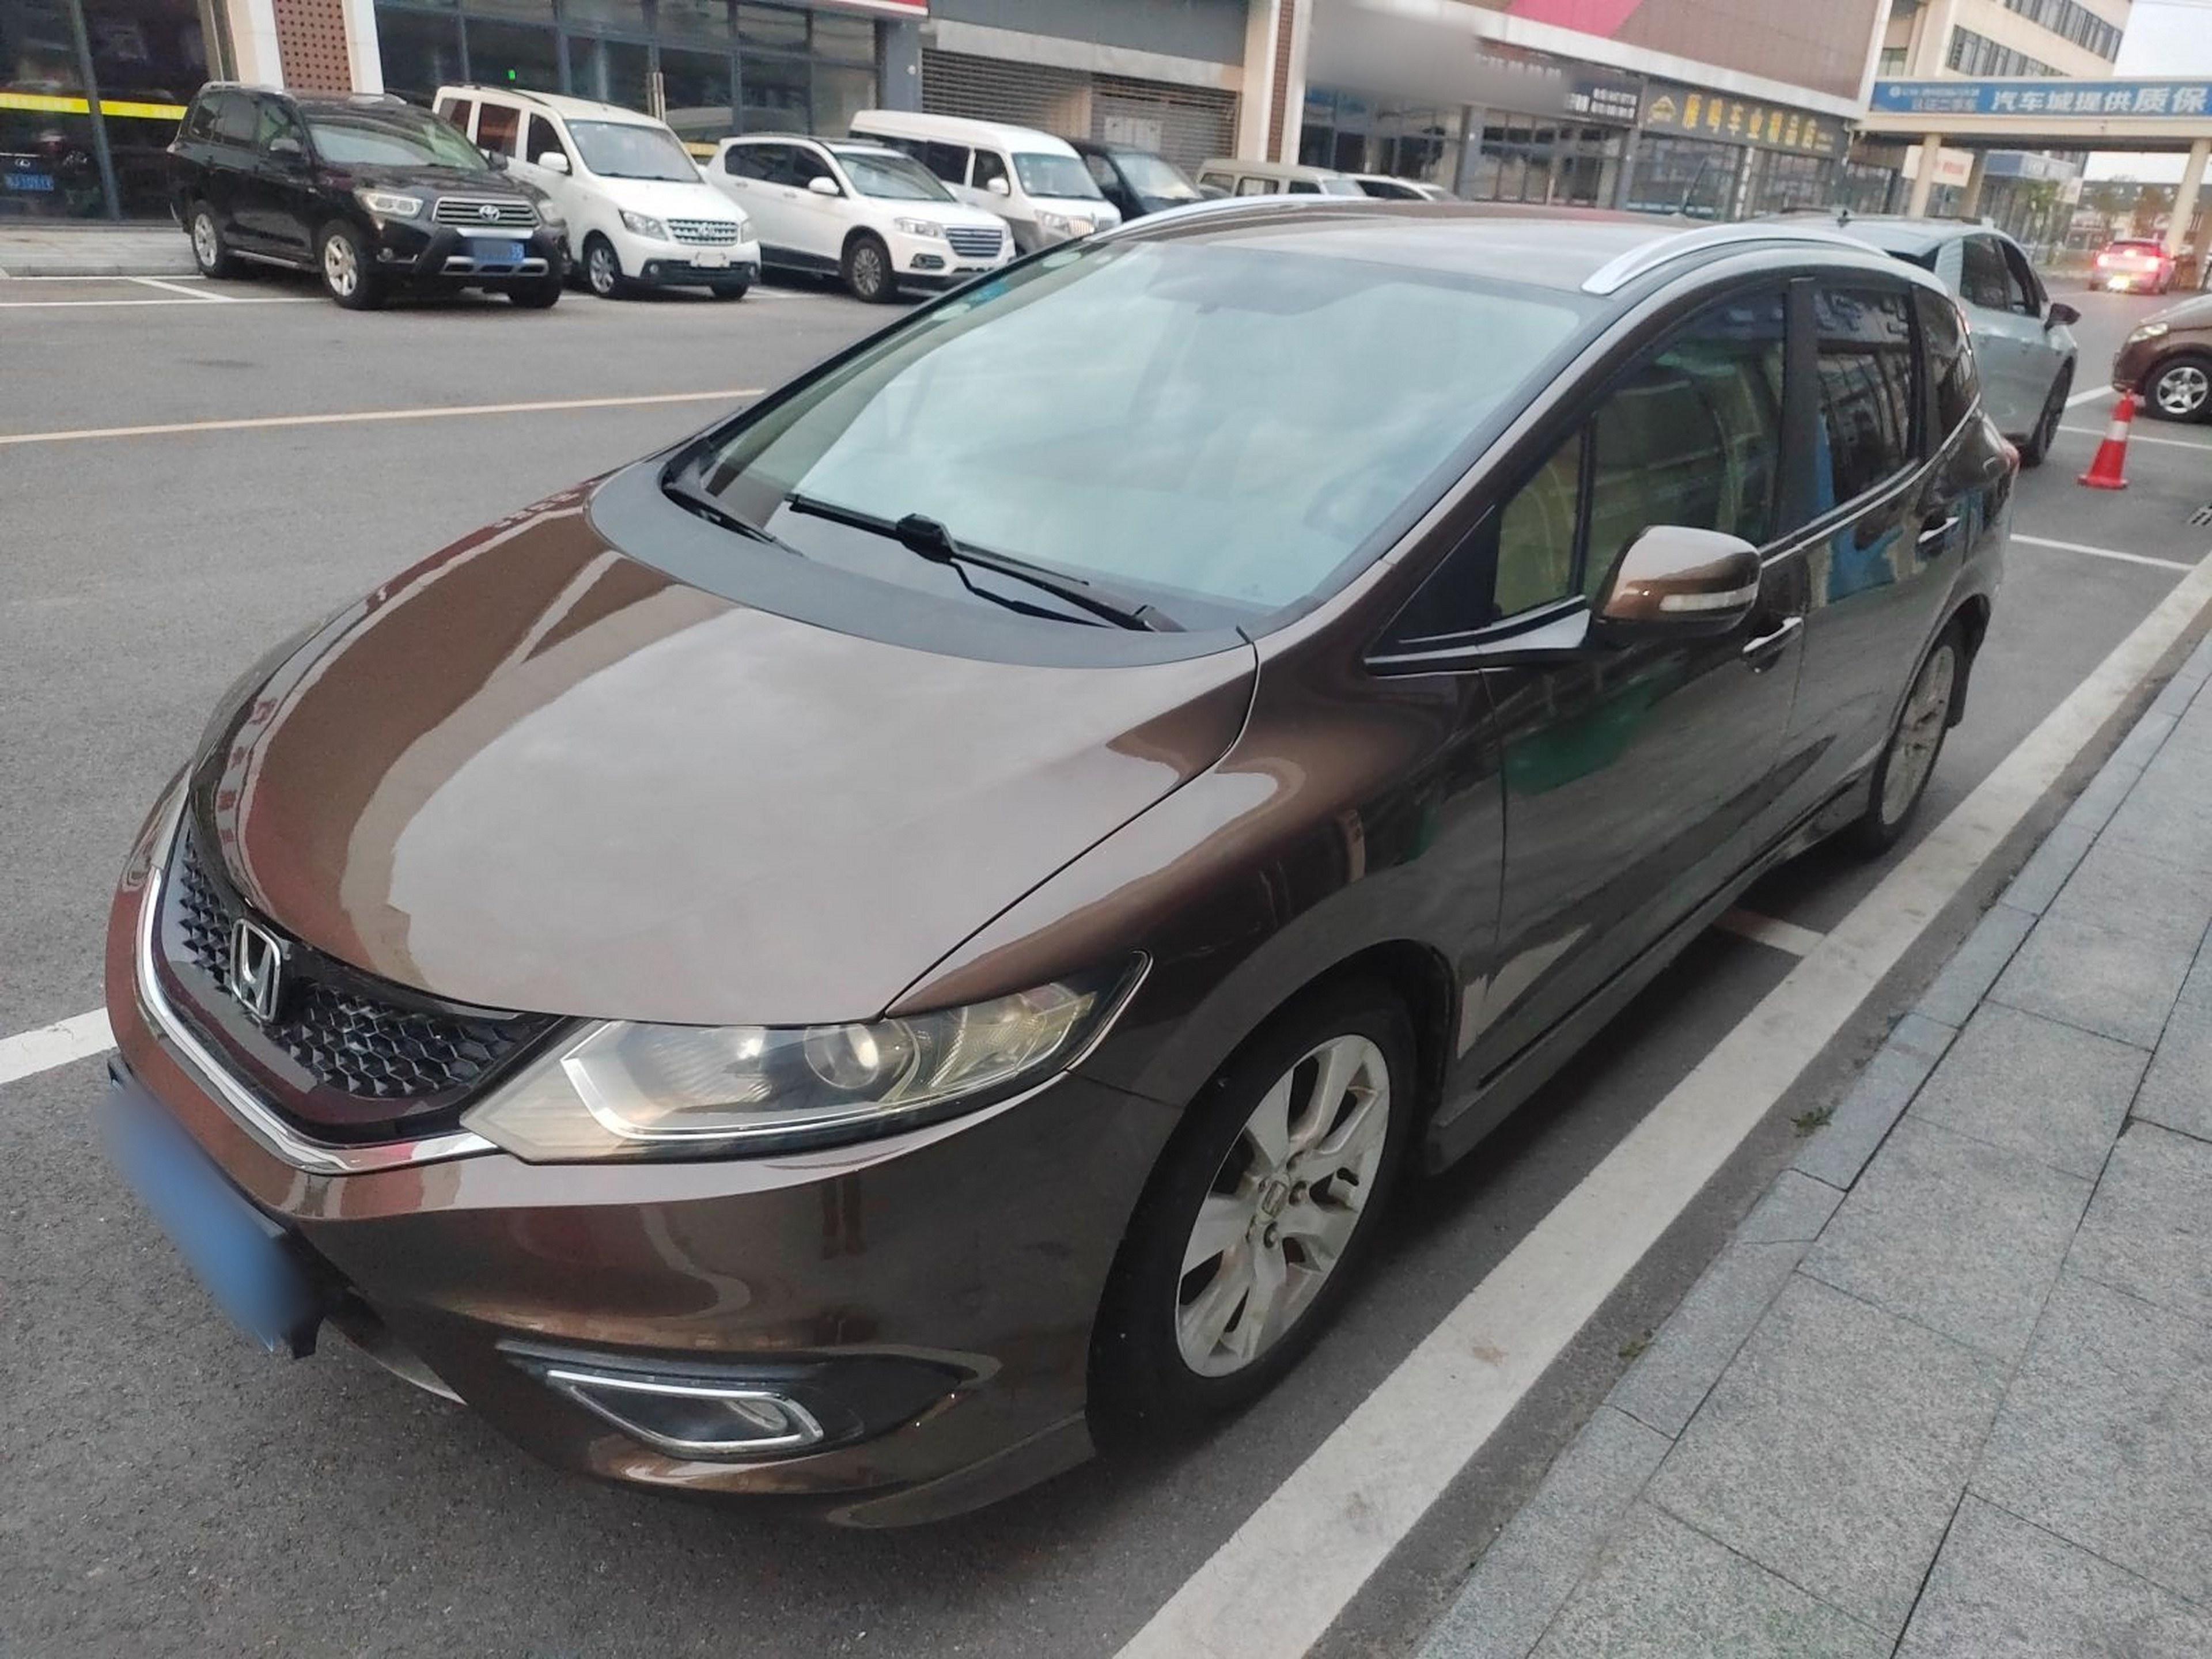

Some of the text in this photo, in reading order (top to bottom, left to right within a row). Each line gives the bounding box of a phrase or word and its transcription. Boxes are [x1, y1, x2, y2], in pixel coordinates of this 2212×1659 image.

[1991, 87, 2207, 113] 汽车城提供质保
